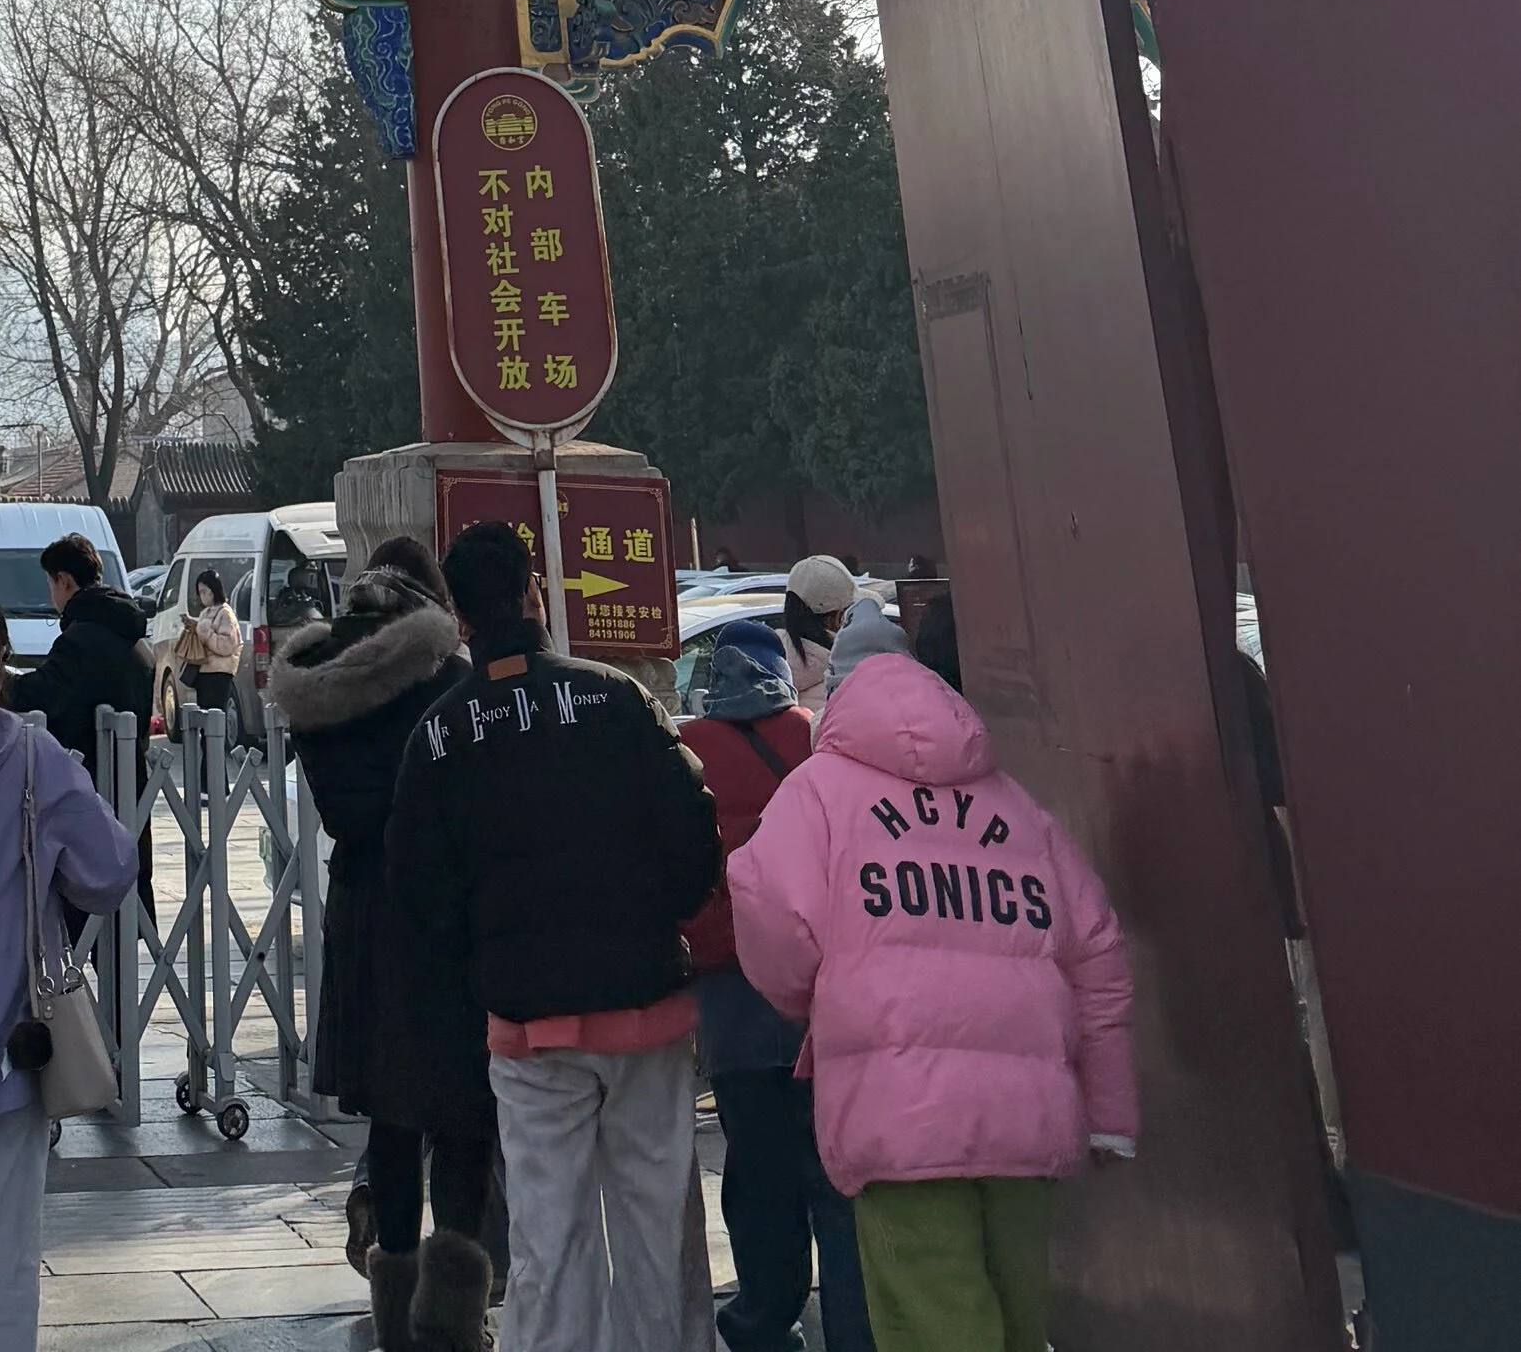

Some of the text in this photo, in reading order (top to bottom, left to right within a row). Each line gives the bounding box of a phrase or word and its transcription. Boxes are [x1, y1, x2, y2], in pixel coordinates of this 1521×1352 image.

[478, 169, 531, 391] 不对社会开放
[525, 164, 578, 390] 内部车场
[586, 603, 663, 620] 请您接受安检
[870, 787, 1010, 848] HCYP
[860, 861, 1052, 930] SONICS
